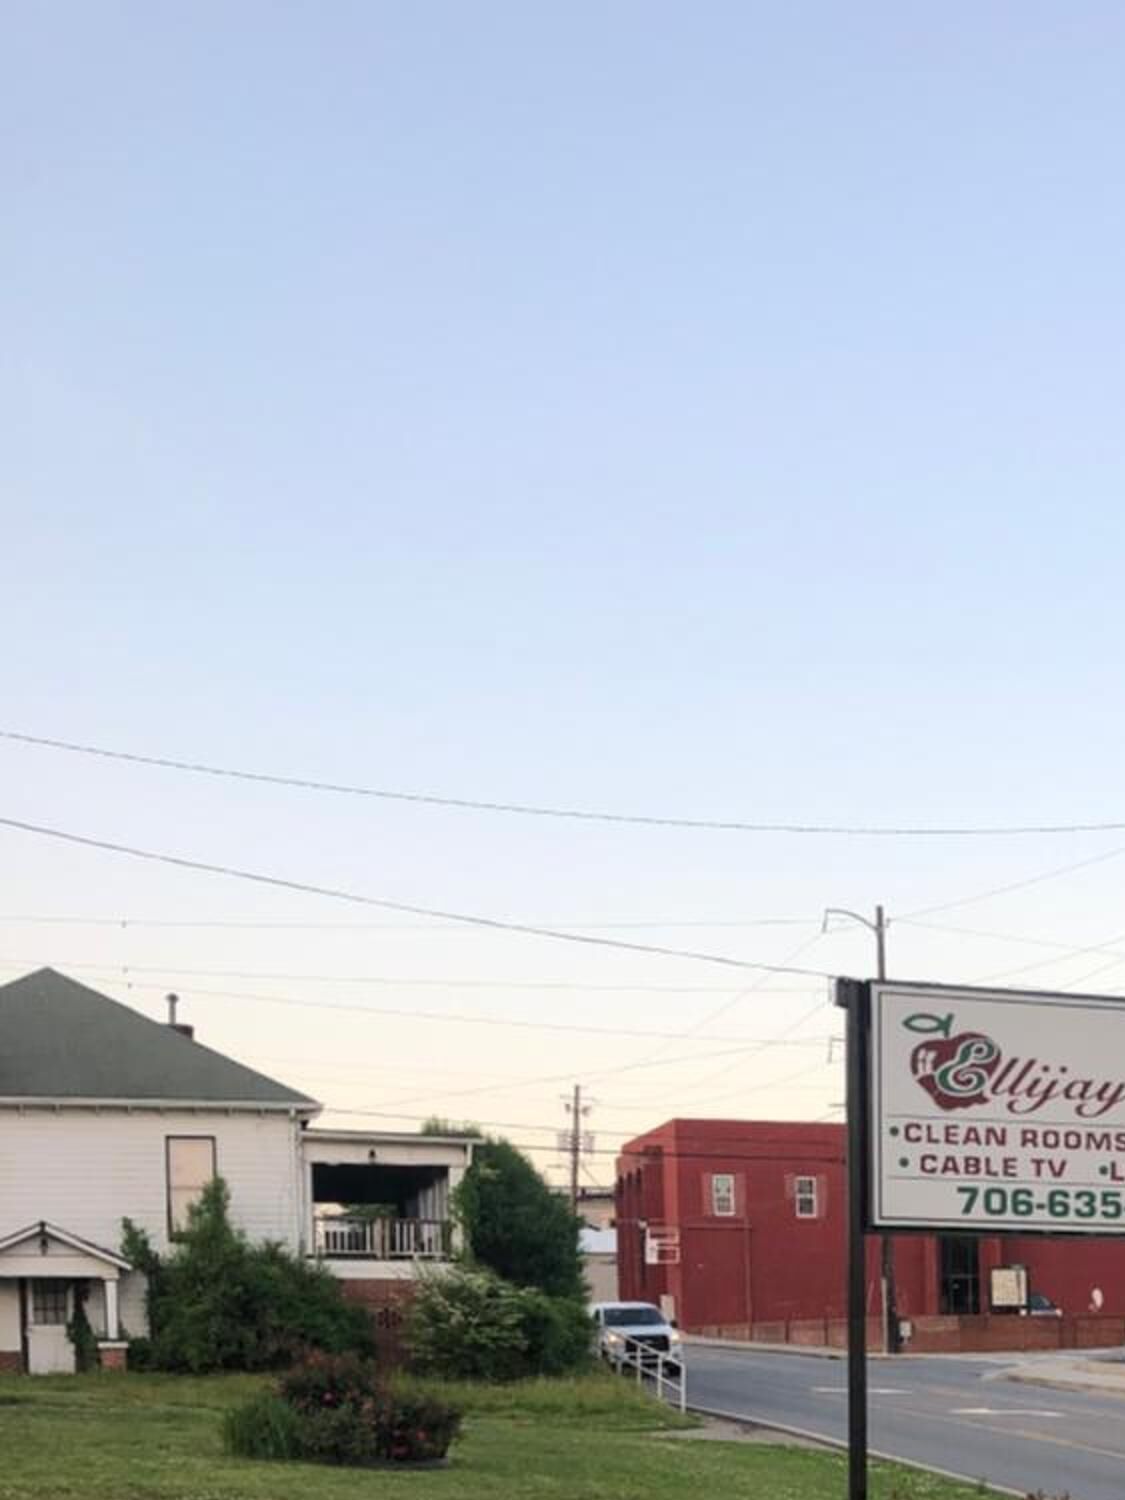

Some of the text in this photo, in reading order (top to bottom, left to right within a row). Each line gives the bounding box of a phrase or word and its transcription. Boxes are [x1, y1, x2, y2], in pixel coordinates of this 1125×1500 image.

[904, 1123, 1007, 1147] CLEAN
[919, 1154, 1067, 1178] CABLE TV
